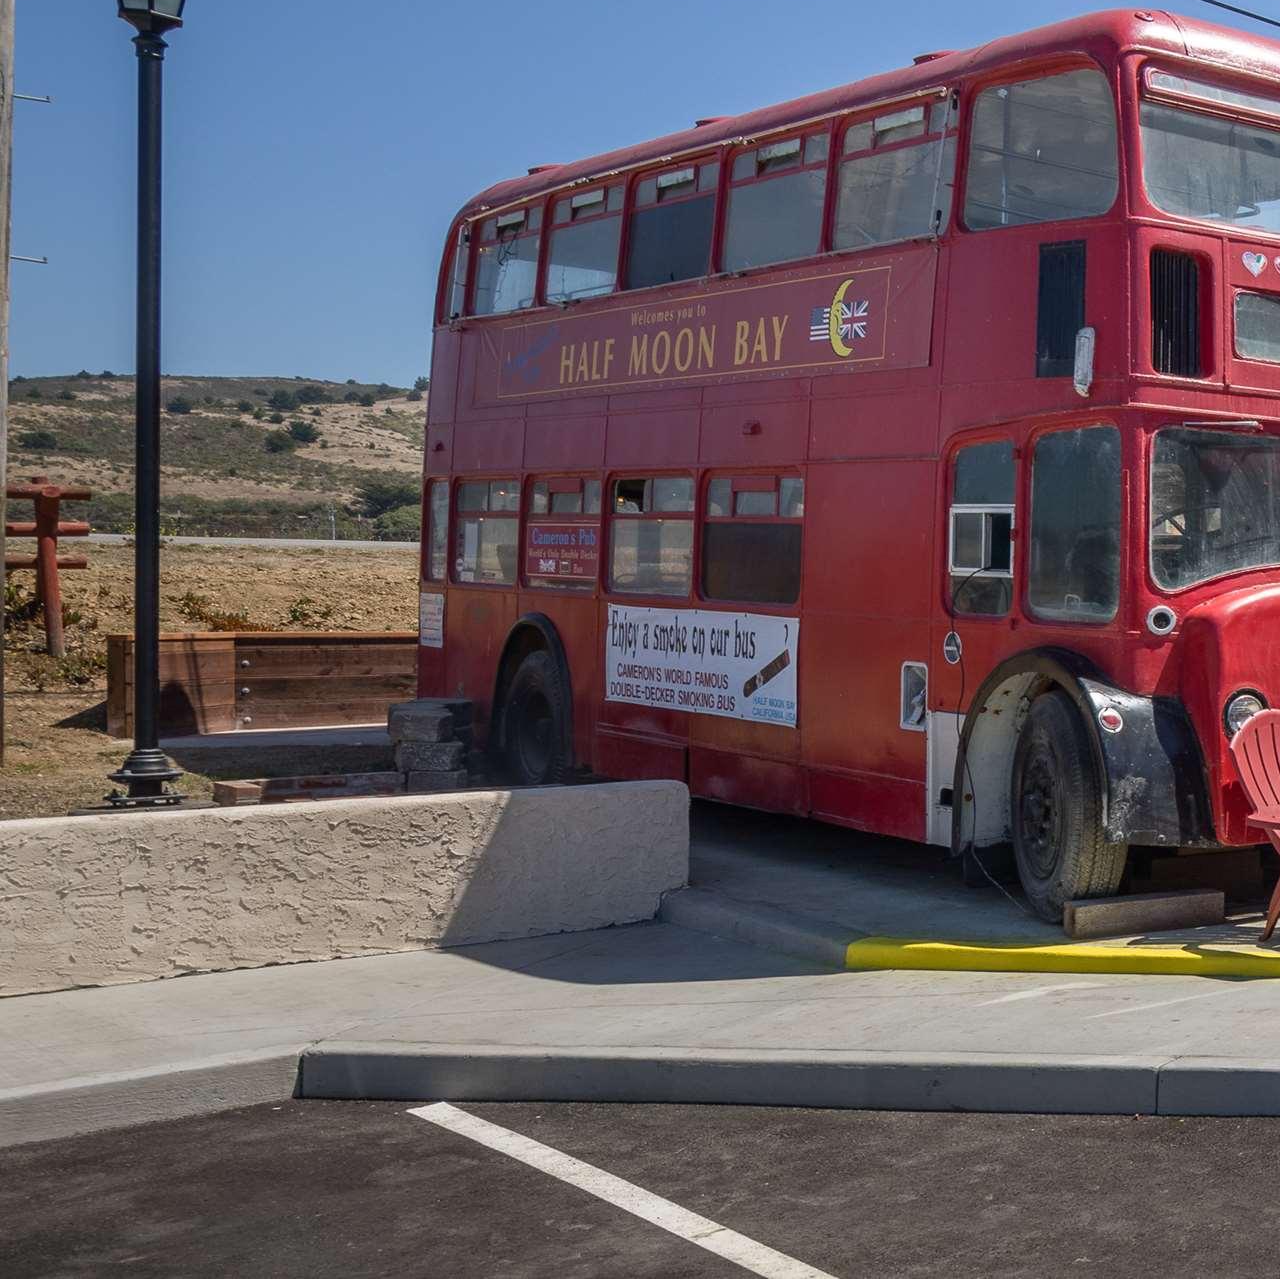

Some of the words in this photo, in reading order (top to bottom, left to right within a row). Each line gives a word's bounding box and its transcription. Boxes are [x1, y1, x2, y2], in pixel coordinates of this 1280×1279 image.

[631, 310, 675, 326] Welcomes
[677, 308, 694, 324] you
[697, 304, 706, 318] to
[559, 338, 615, 384] HALF
[628, 324, 716, 377] MOON
[733, 315, 789, 365] BAY
[532, 527, 576, 545] Cameron's
[579, 528, 596, 545] Pub
[610, 610, 640, 658] Enjoy
[642, 623, 650, 651] a
[653, 616, 688, 660] smoke
[692, 626, 705, 661] on
[710, 627, 730, 657] our
[734, 619, 756, 660] bus
[617, 663, 662, 683] CAMERON'S
[665, 669, 691, 686] WORLD
[695, 672, 729, 690] FAMOUS
[610, 682, 676, 704] DOUBLE-DECKER
[678, 690, 714, 708] SMOKING
[717, 695, 736, 711] BUS
